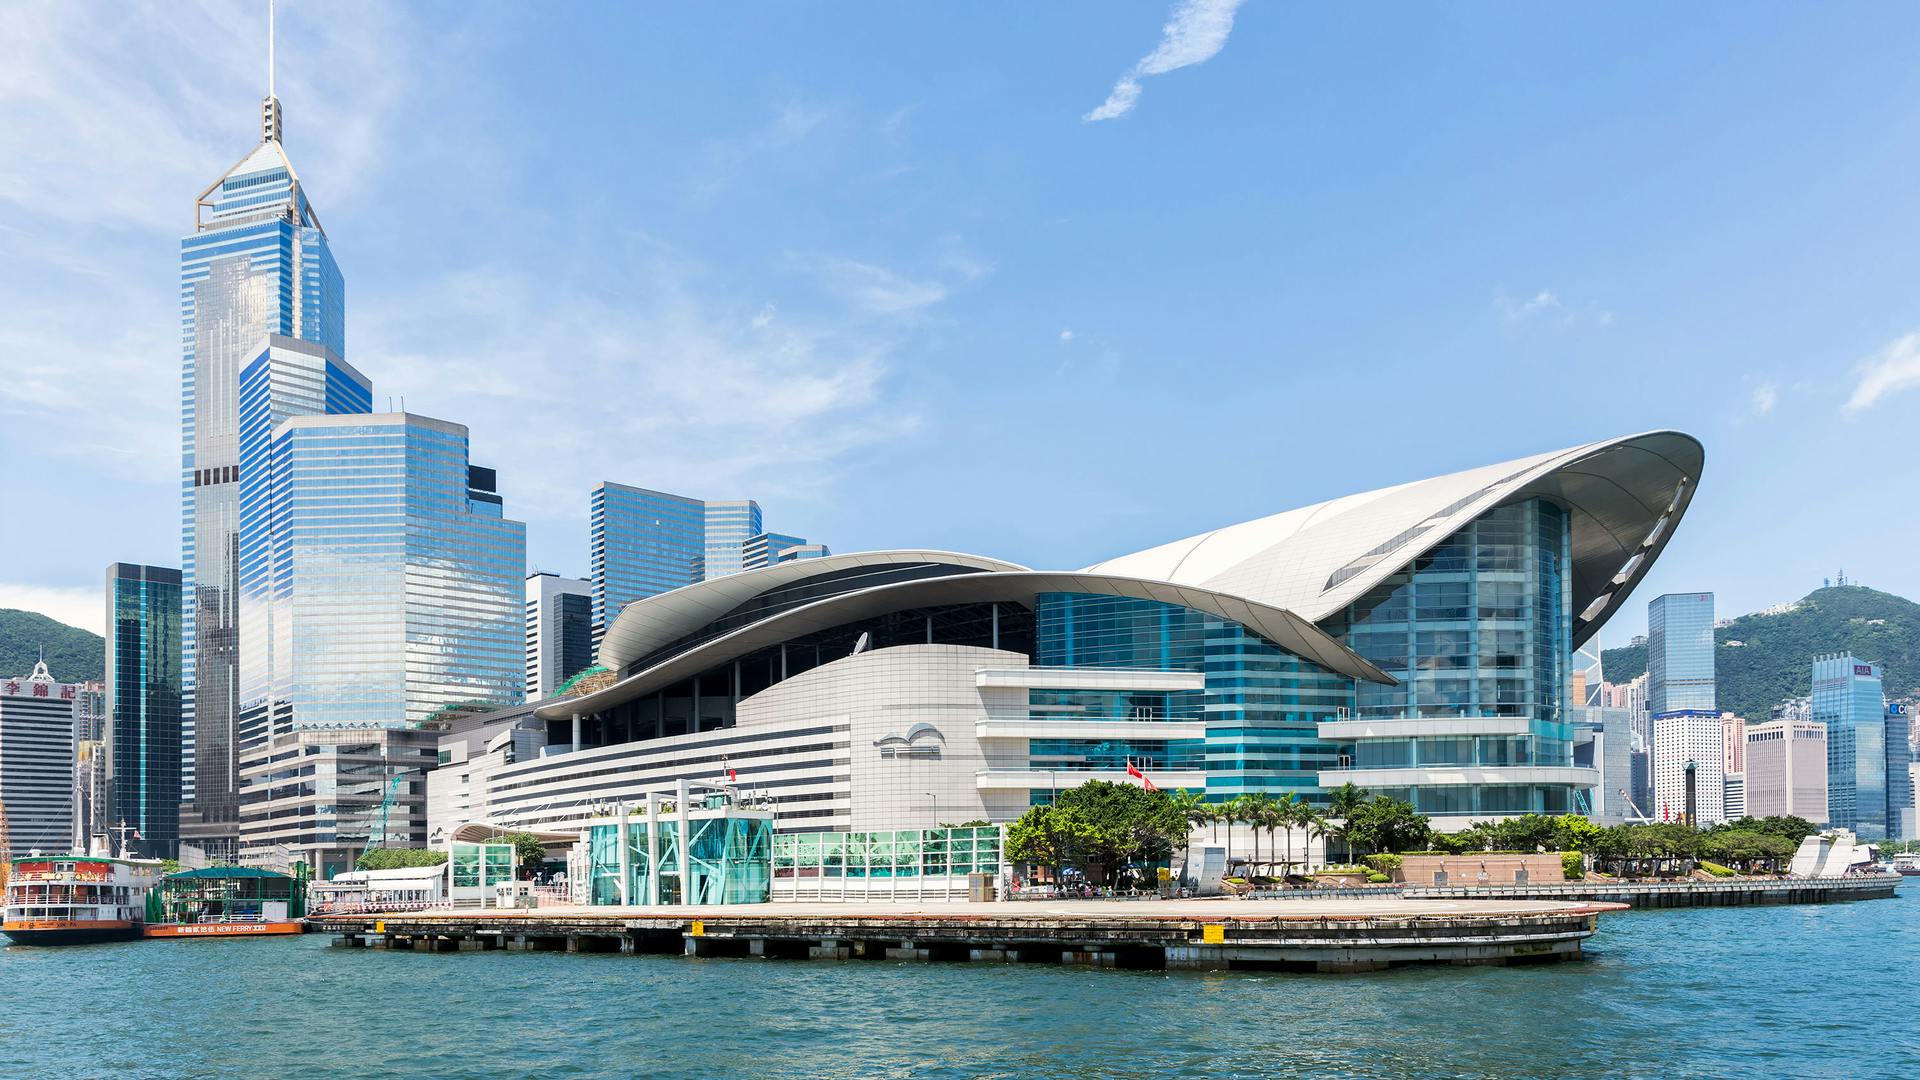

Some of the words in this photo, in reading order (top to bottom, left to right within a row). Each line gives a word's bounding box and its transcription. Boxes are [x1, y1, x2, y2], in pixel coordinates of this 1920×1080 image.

[1856, 666, 1870, 675] AIA
[4, 681, 76, 699] 李錦記
